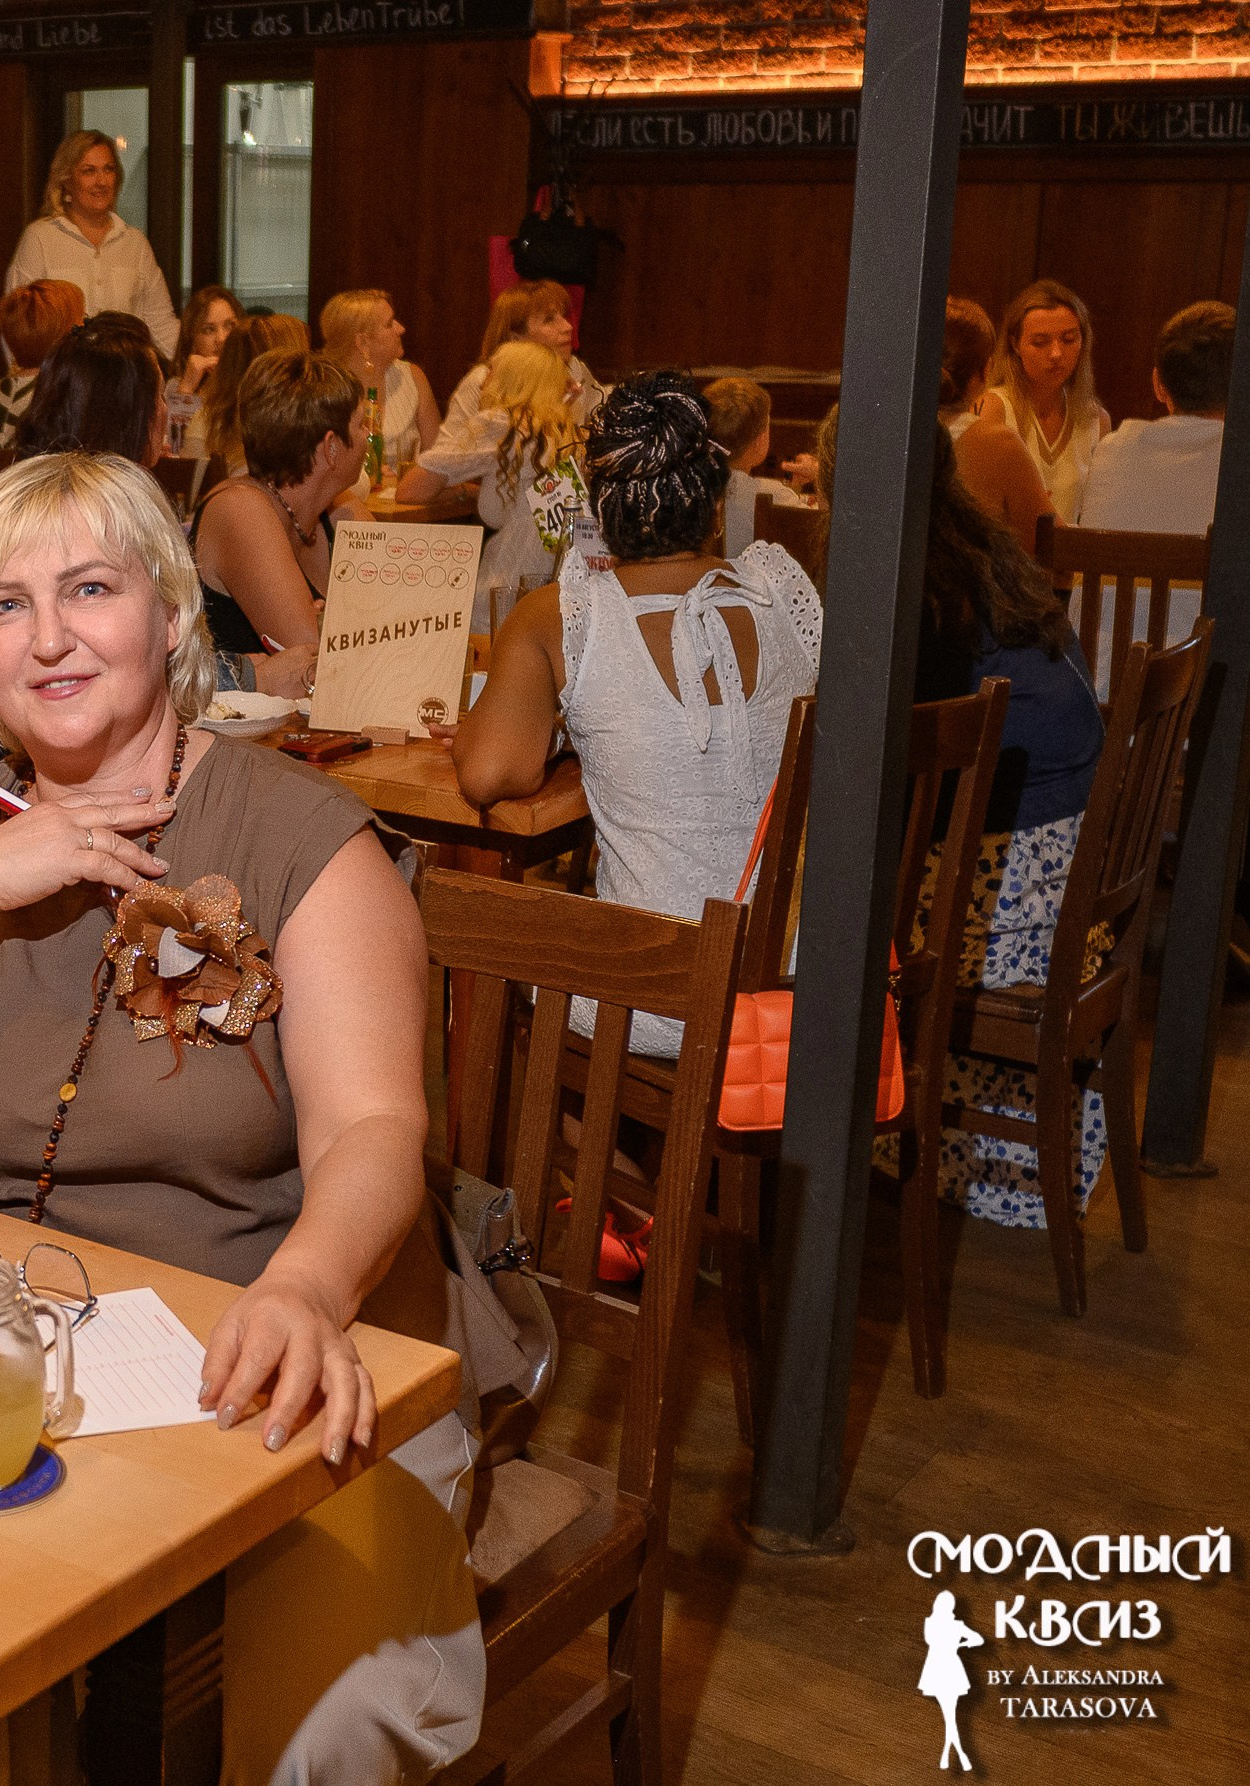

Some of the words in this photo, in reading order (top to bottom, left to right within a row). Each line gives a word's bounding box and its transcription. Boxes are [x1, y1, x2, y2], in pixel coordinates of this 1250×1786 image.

[37, 19, 102, 48] Liebe
[204, 10, 239, 39] ist
[252, 10, 292, 37] das
[701, 109, 811, 147] ЛЮБОВЬ
[960, 105, 1035, 142] АЧИТ
[1057, 104, 1098, 141] ТЫ
[348, 541, 374, 551] КВИЗ
[326, 611, 463, 653] КВИЗАНУТЫЕ
